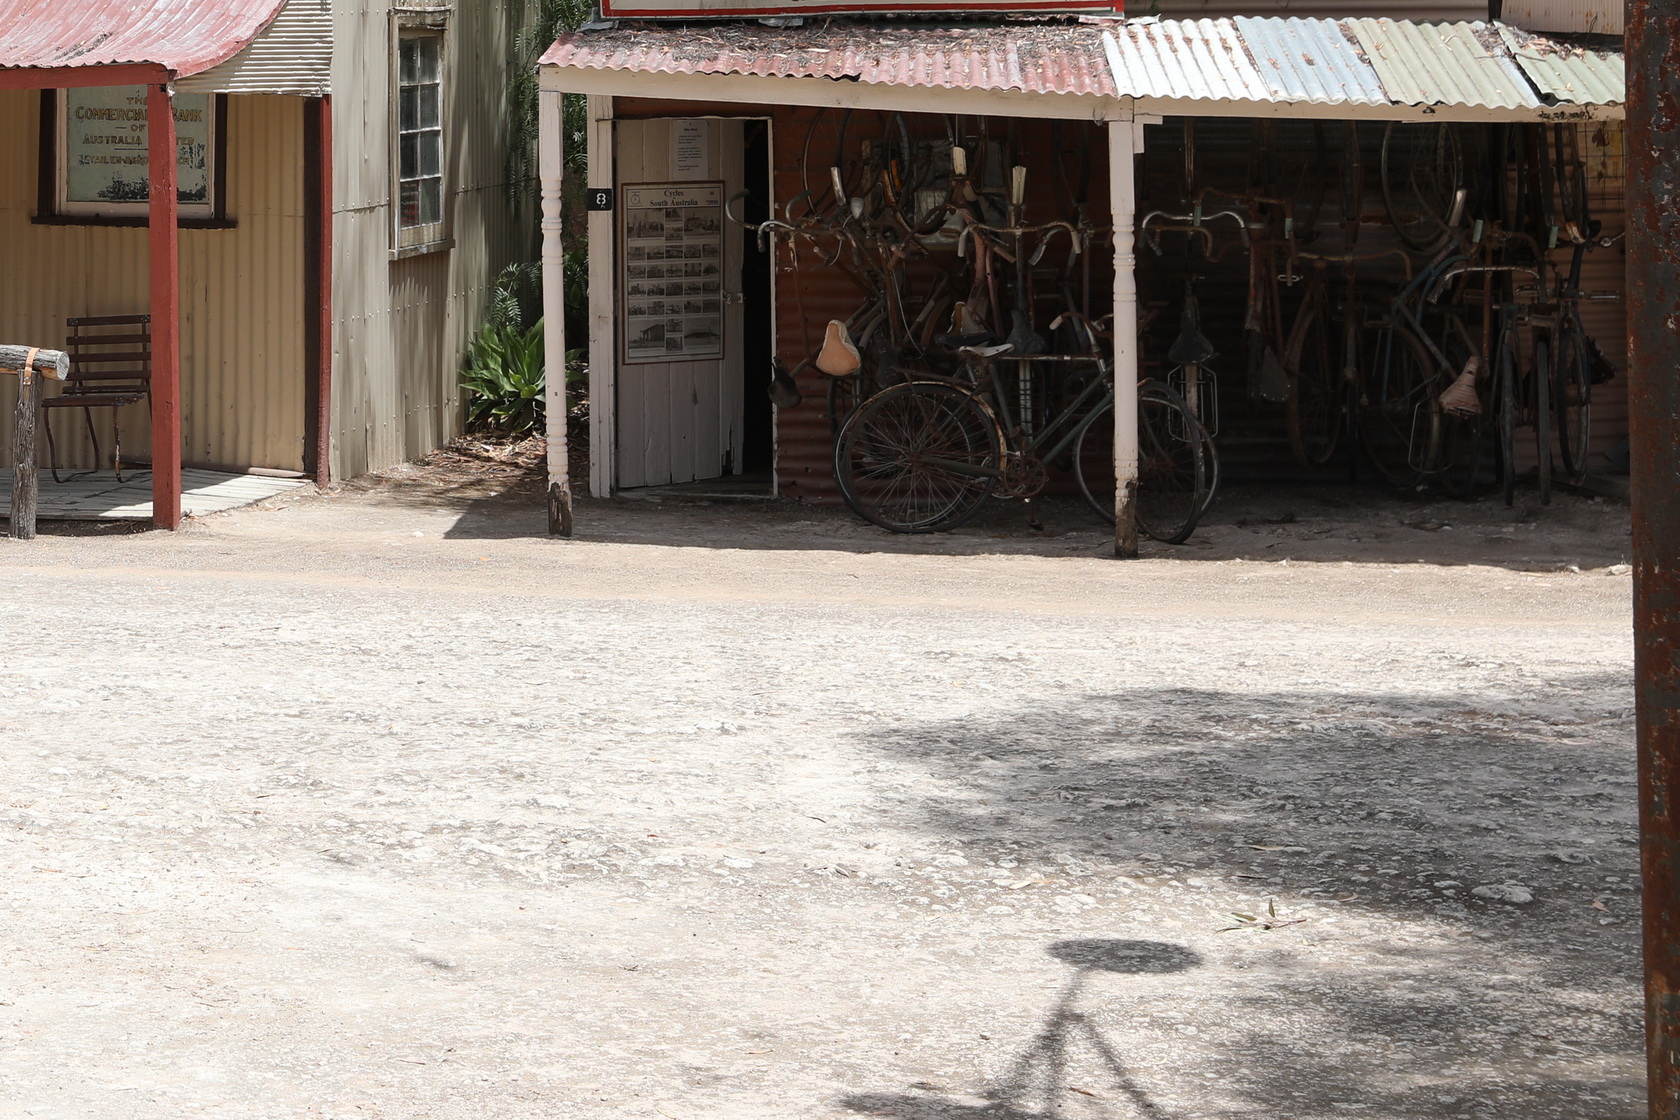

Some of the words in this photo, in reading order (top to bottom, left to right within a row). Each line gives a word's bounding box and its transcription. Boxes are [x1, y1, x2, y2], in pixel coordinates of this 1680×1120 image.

[130, 124, 146, 132] OF
[82, 134, 143, 145] AUSTRALIA
[596, 192, 606, 205] 8
[663, 190, 684, 199] Cycles
[649, 199, 669, 207] South
[670, 198, 698, 206] Australia
